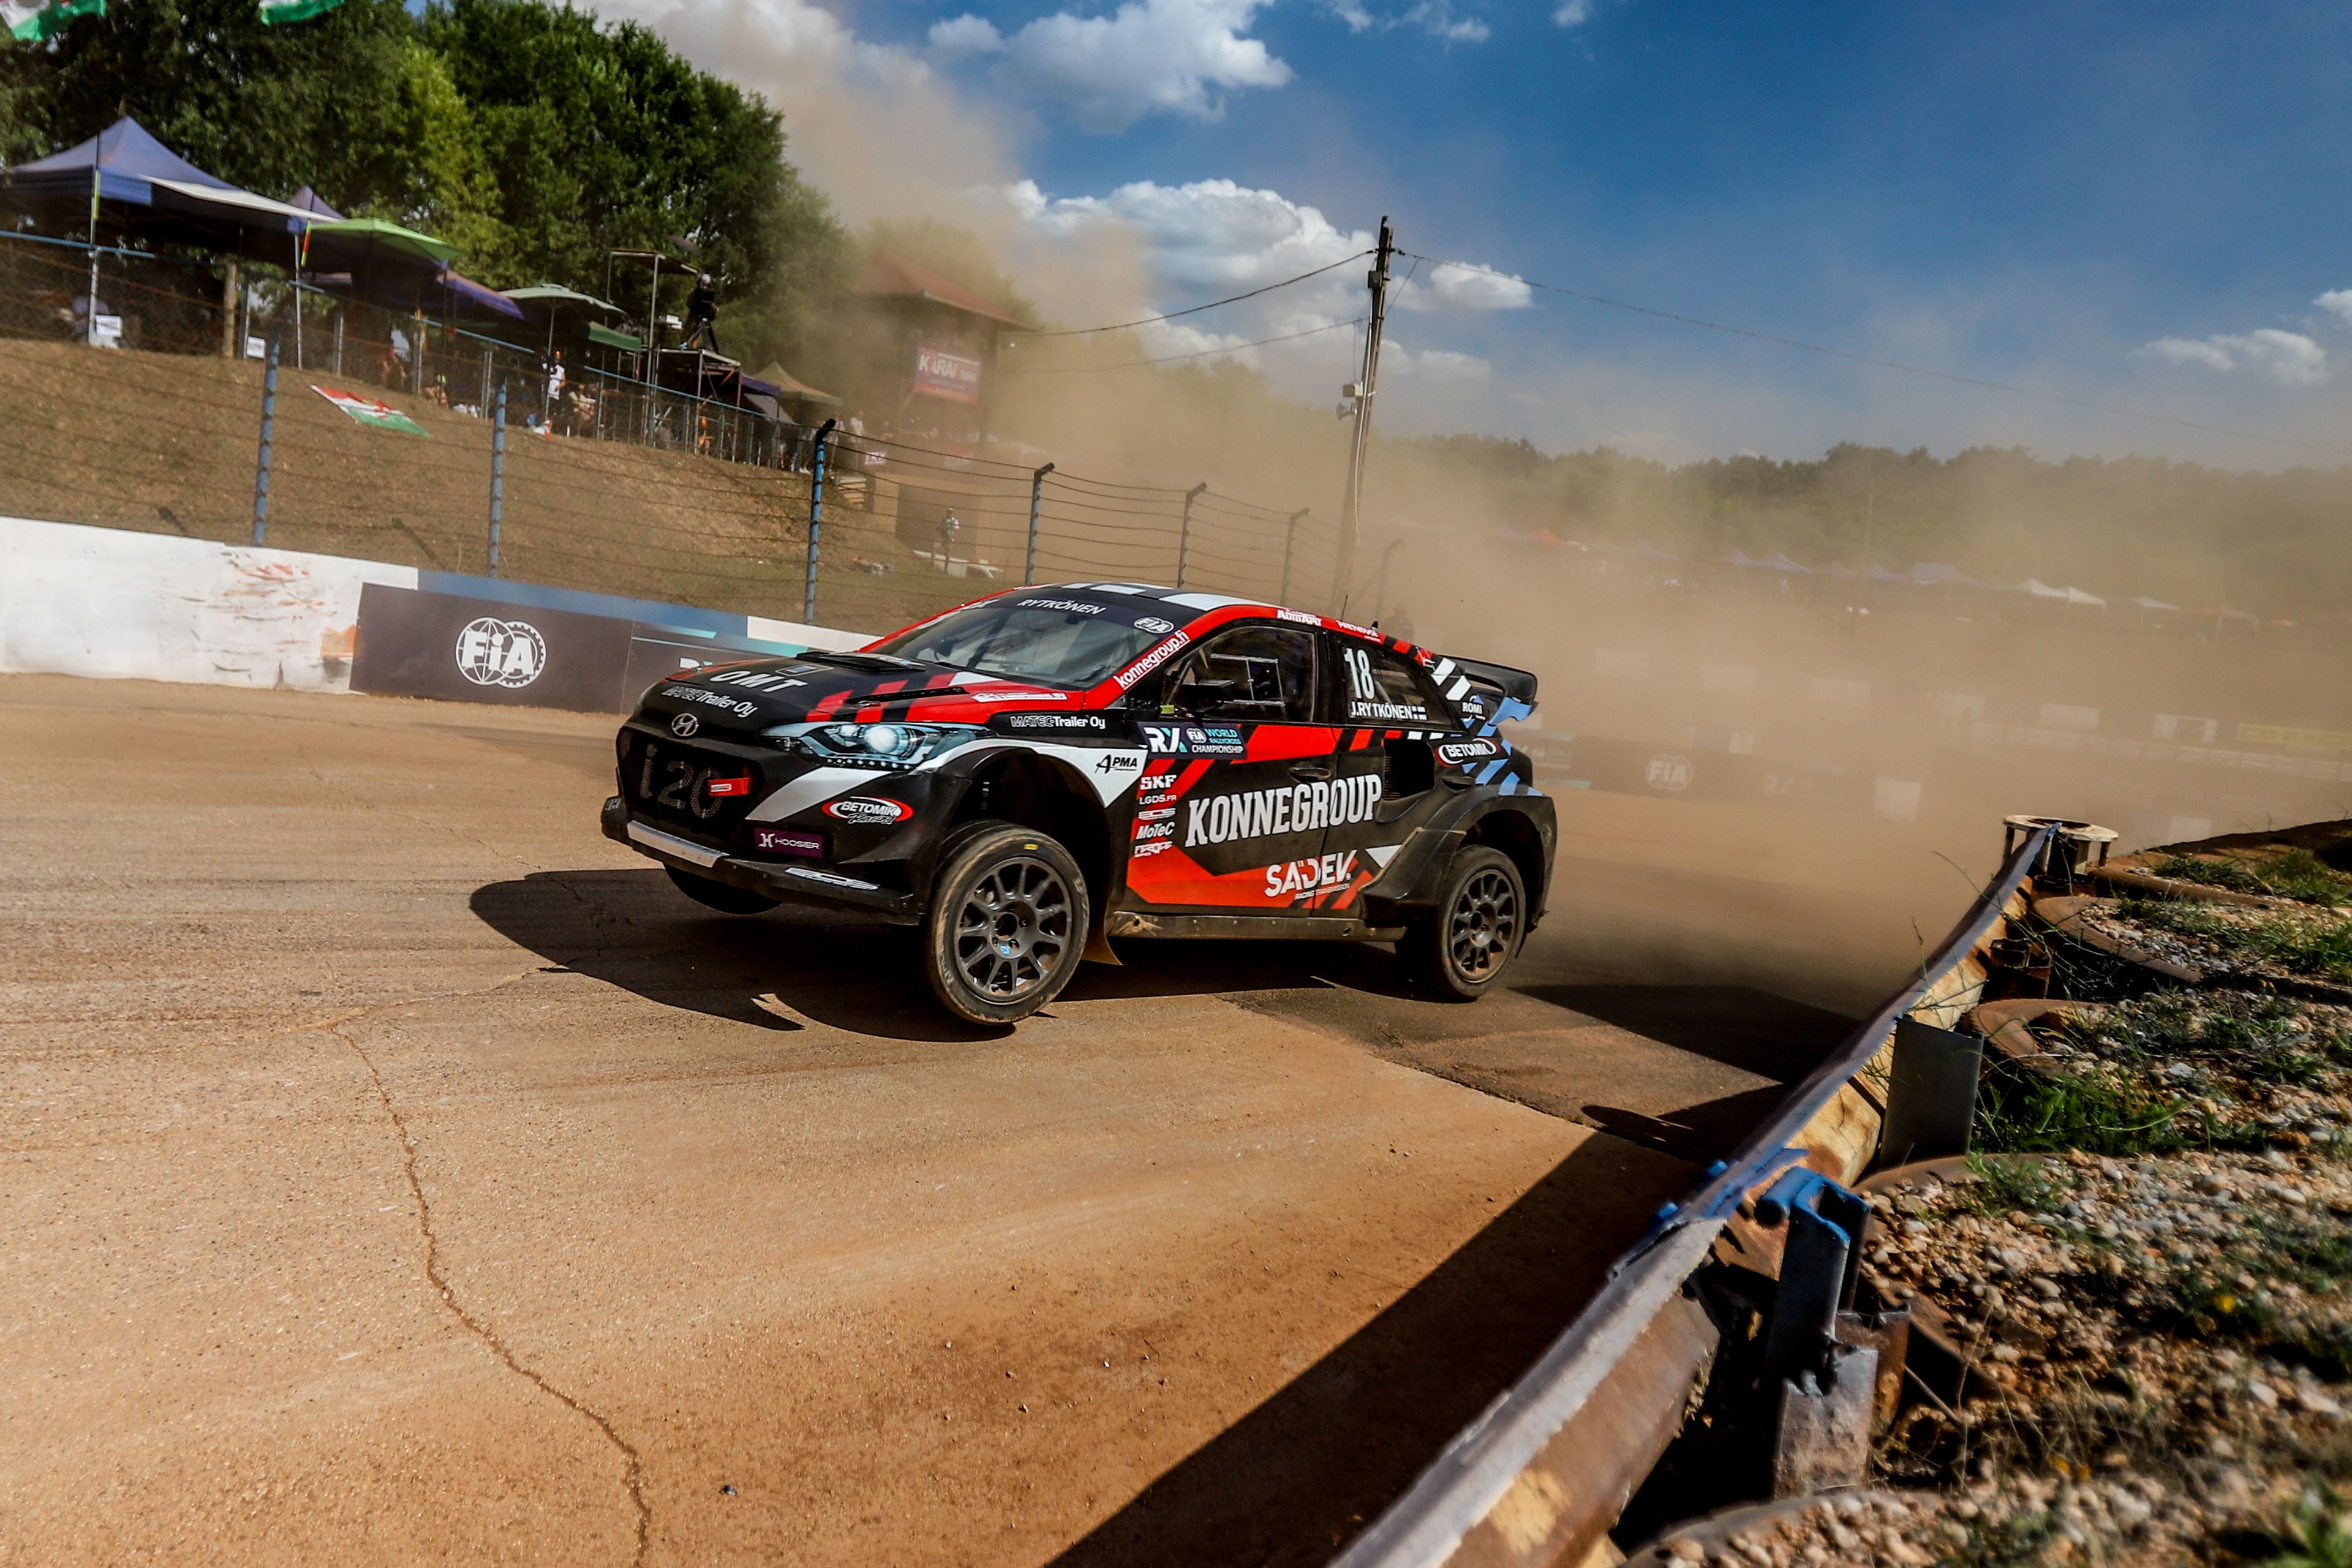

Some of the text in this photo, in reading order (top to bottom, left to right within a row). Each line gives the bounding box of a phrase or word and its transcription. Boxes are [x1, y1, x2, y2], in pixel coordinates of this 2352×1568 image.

[1017, 598, 1106, 614] RYTKÖNEN
[1113, 630, 1190, 688] konnegroup.fi
[710, 670, 808, 693] OMT
[1343, 648, 1375, 699] 18
[733, 701, 758, 718] Oy
[1462, 702, 1483, 714] ROMI
[1090, 716, 1106, 729] Oy
[1143, 727, 1188, 753] RX
[1205, 728, 1238, 738] WORLD
[1191, 745, 1244, 754] CHAMPIONSHIP
[1140, 775, 1177, 790] SKF
[1139, 794, 1177, 805] LGDS.FR
[841, 801, 897, 816] BETOMIK
[1185, 774, 1382, 847] KONNEGROUP
[1136, 821, 1175, 840] MoTeC
[775, 837, 820, 850] HOOSIER
[1264, 850, 1357, 897] SADEV
